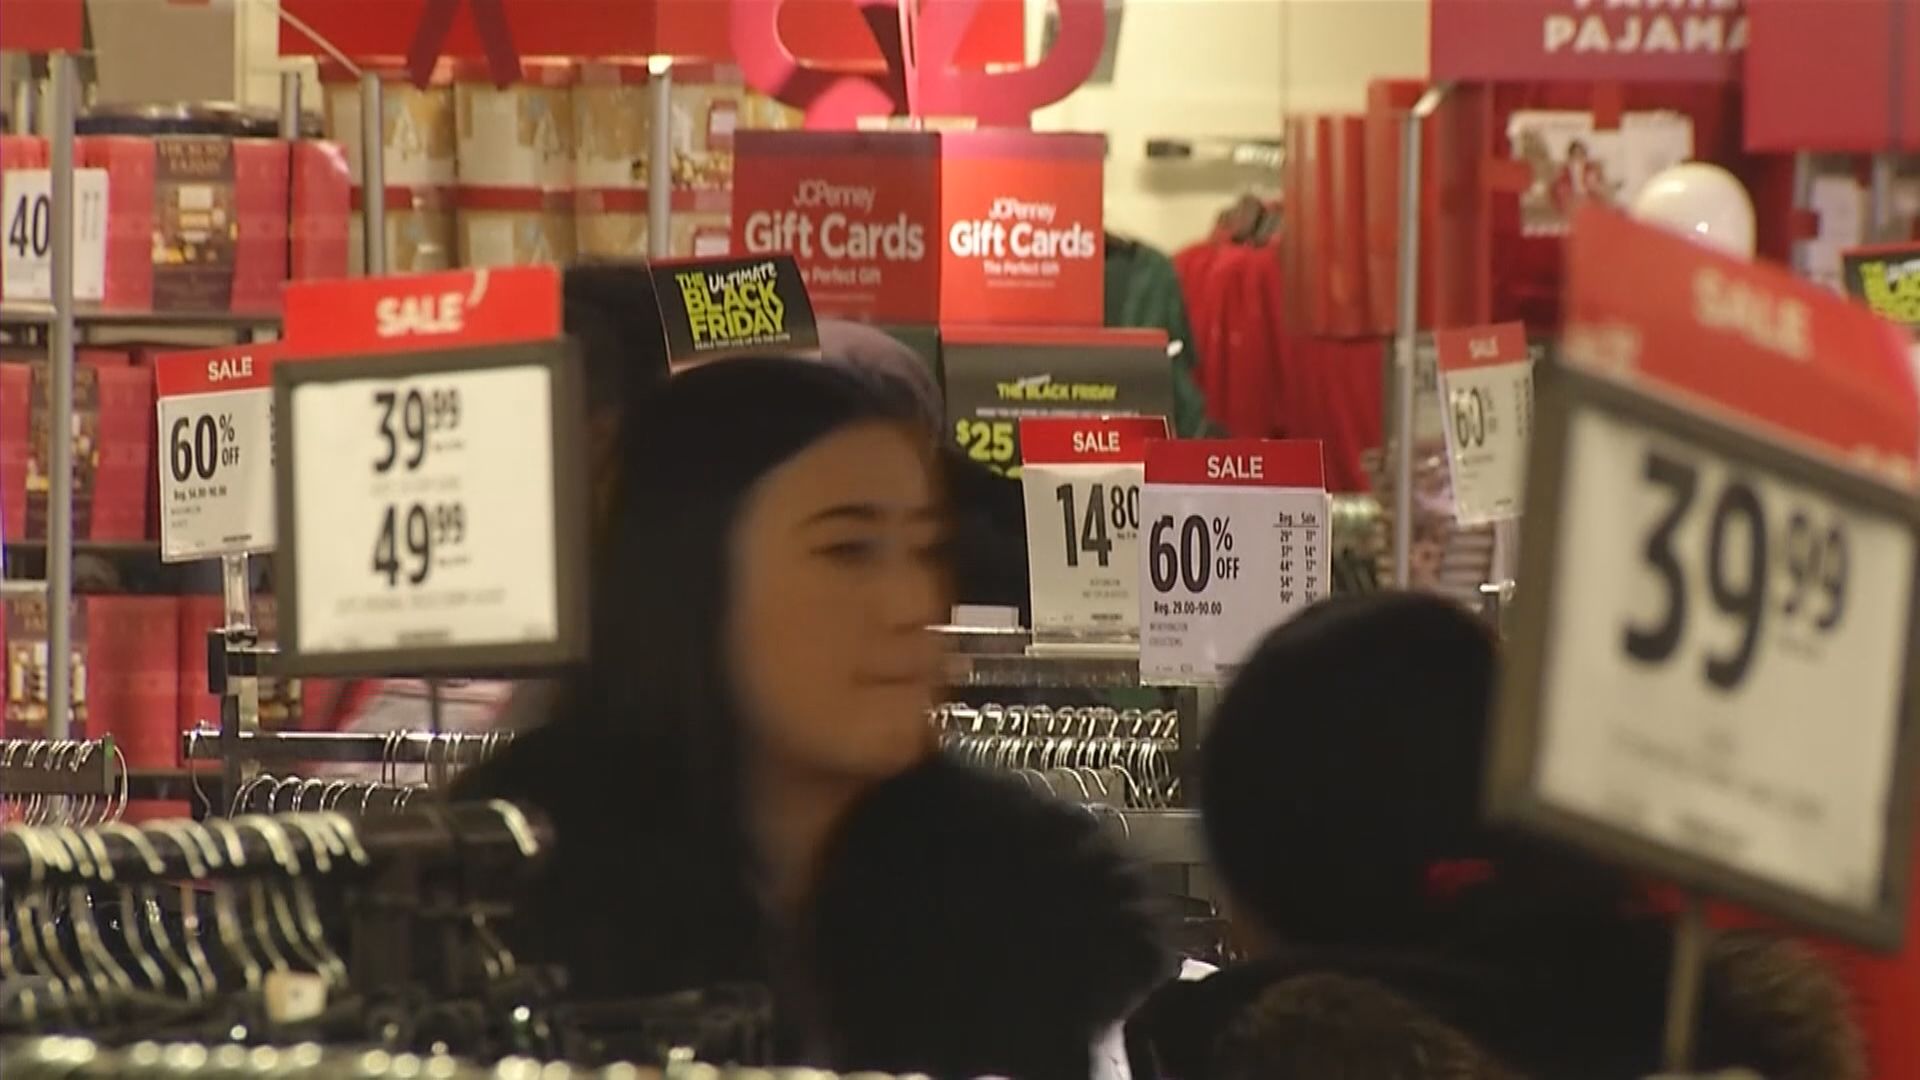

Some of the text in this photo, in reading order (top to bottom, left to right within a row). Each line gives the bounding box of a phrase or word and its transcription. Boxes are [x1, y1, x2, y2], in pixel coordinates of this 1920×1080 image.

[793, 179, 876, 213] JCPenney
[9, 193, 50, 257] 40
[744, 210, 925, 260] Gift Cards
[949, 219, 1095, 258] Gift Cards
[675, 261, 778, 294] THE ULTIMATE
[812, 265, 882, 286] Perfect Gift
[375, 292, 464, 338] SALE
[684, 279, 783, 315] BLACK
[1693, 266, 1812, 360] SALE
[690, 301, 785, 343] FRIDAY
[207, 357, 253, 382] SALE
[1026, 383, 1070, 399] BLACK
[169, 414, 219, 482] 60
[221, 446, 240, 467] OFF
[956, 418, 1014, 462] $25
[1072, 431, 1121, 453] SALE
[1207, 455, 1264, 479] SALE
[1149, 514, 1212, 594] 60
[1216, 557, 1240, 580] OFF
